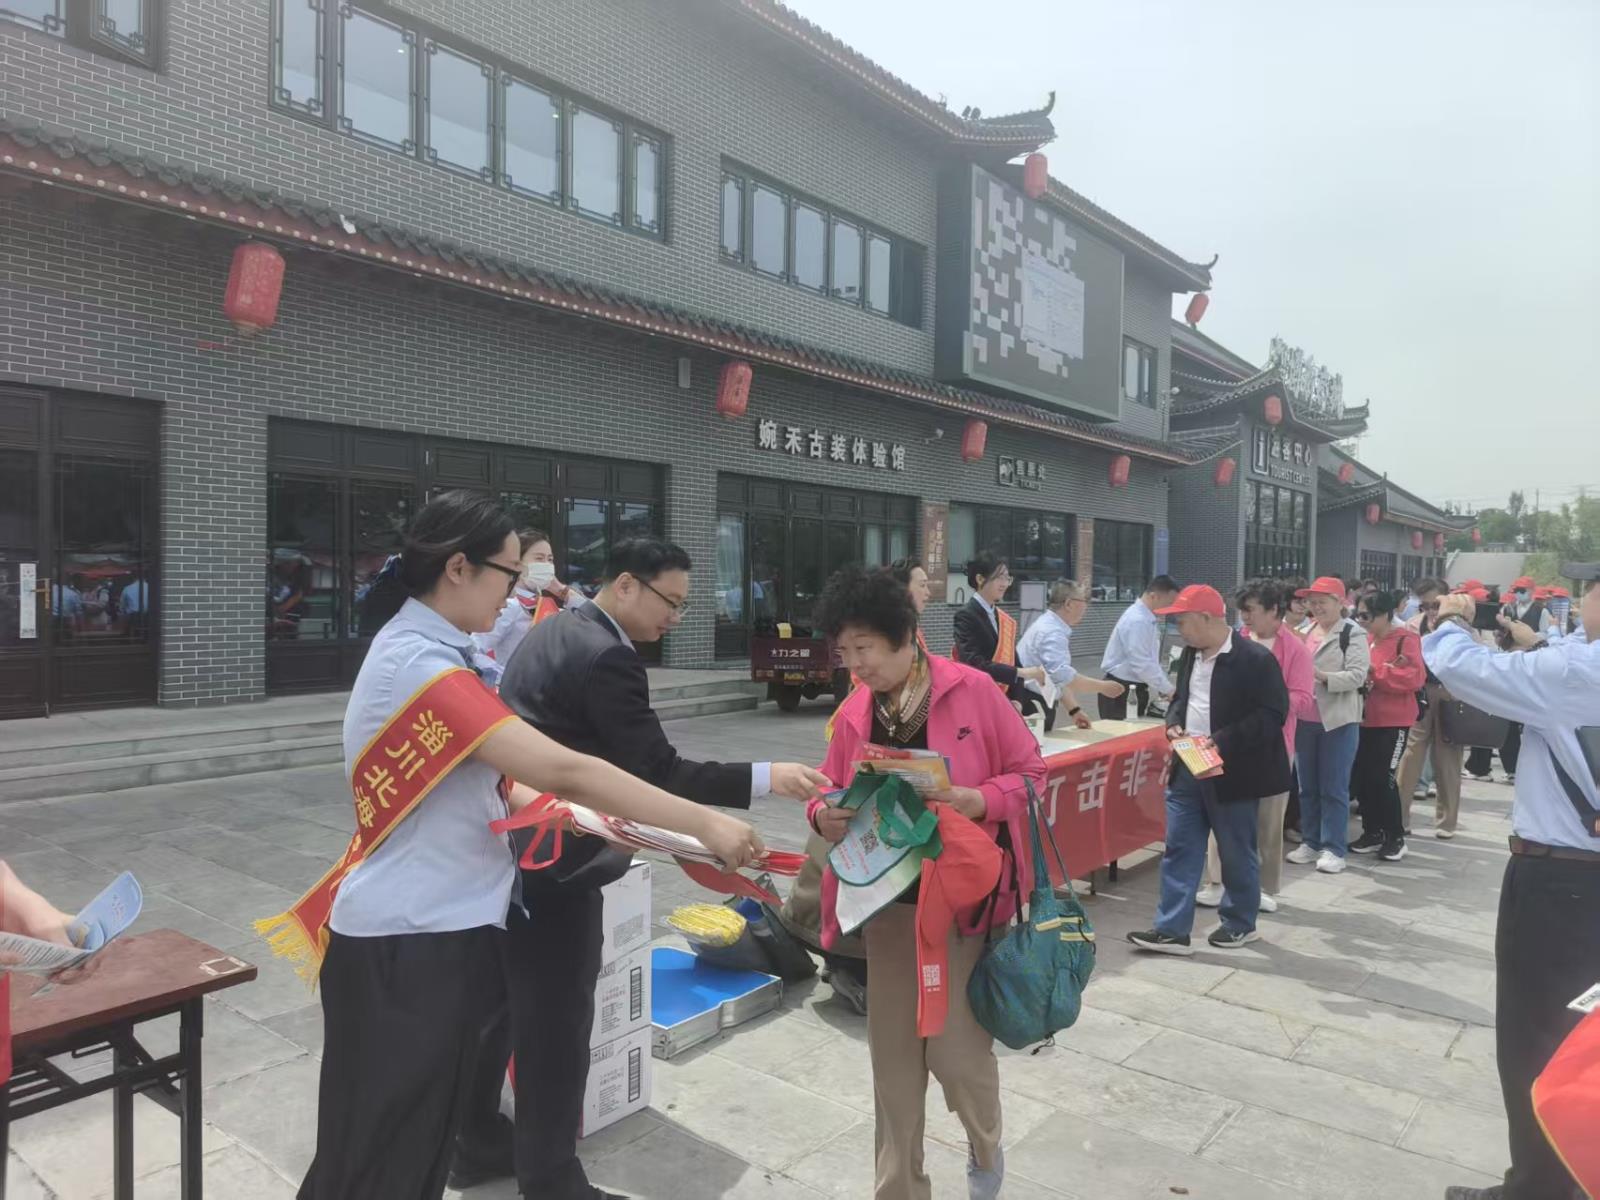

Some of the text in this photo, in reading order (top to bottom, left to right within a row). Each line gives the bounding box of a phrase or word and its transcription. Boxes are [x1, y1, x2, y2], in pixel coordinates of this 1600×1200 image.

[759, 418, 906, 471] 婉禾古装体验馆
